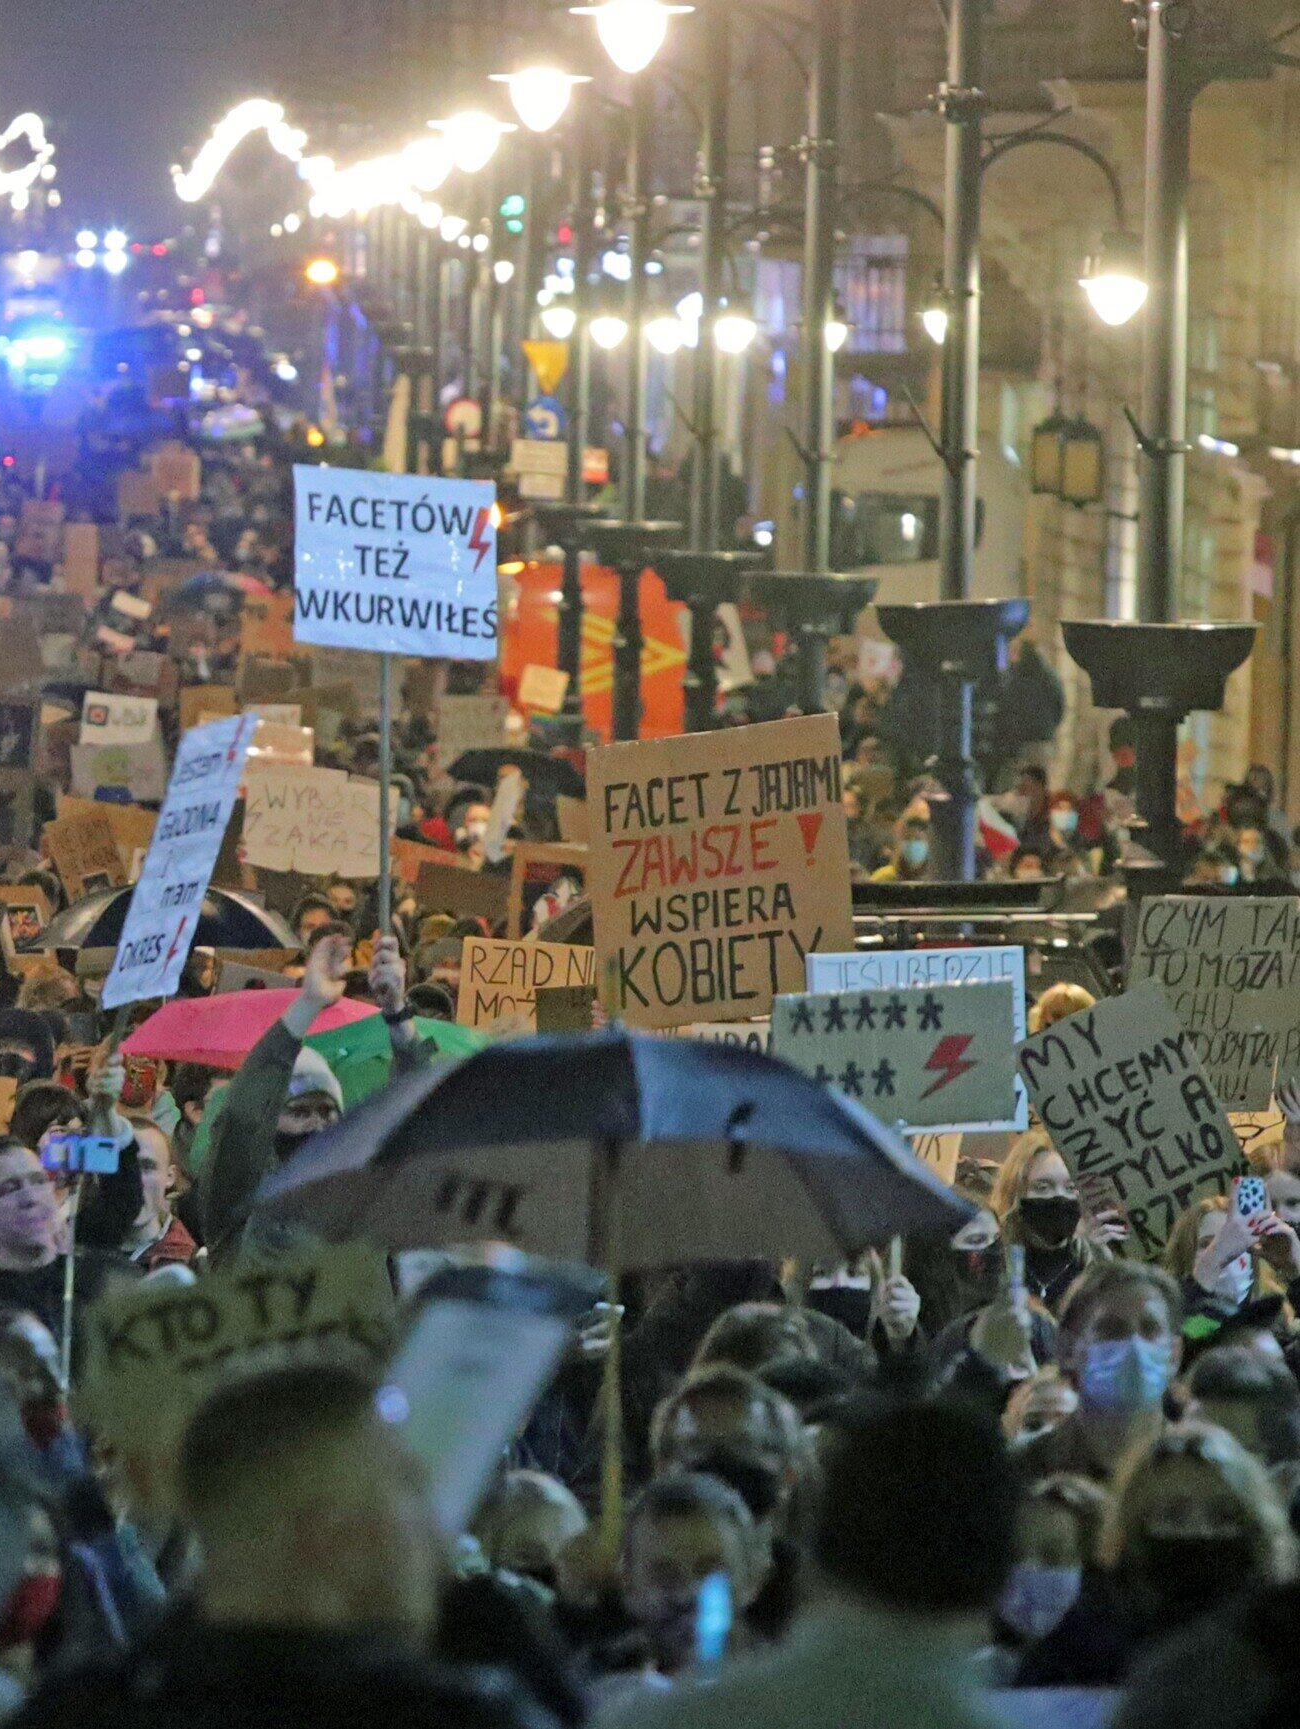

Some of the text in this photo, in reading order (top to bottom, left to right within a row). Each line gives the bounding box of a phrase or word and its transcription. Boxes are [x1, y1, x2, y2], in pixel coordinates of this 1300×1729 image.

[307, 493, 473, 536] FACETÓW
[354, 541, 410, 579] TEŻ
[296, 588, 497, 639] WKURWIŁEŚ
[604, 755, 842, 833] FACET Z JAJAMI
[612, 819, 779, 898] ZAWSZE
[631, 882, 796, 937] WSPIERA
[1141, 902, 1228, 949] CZYM
[118, 933, 167, 973] OKRES
[618, 926, 823, 1010] KOBIETY
[1020, 1012, 1102, 1091] MY
[1042, 1030, 1189, 1131] CHCEMY
[1180, 1074, 1218, 1123] A
[1099, 1122, 1226, 1201] TYLKO
[235, 1267, 320, 1327] TY
